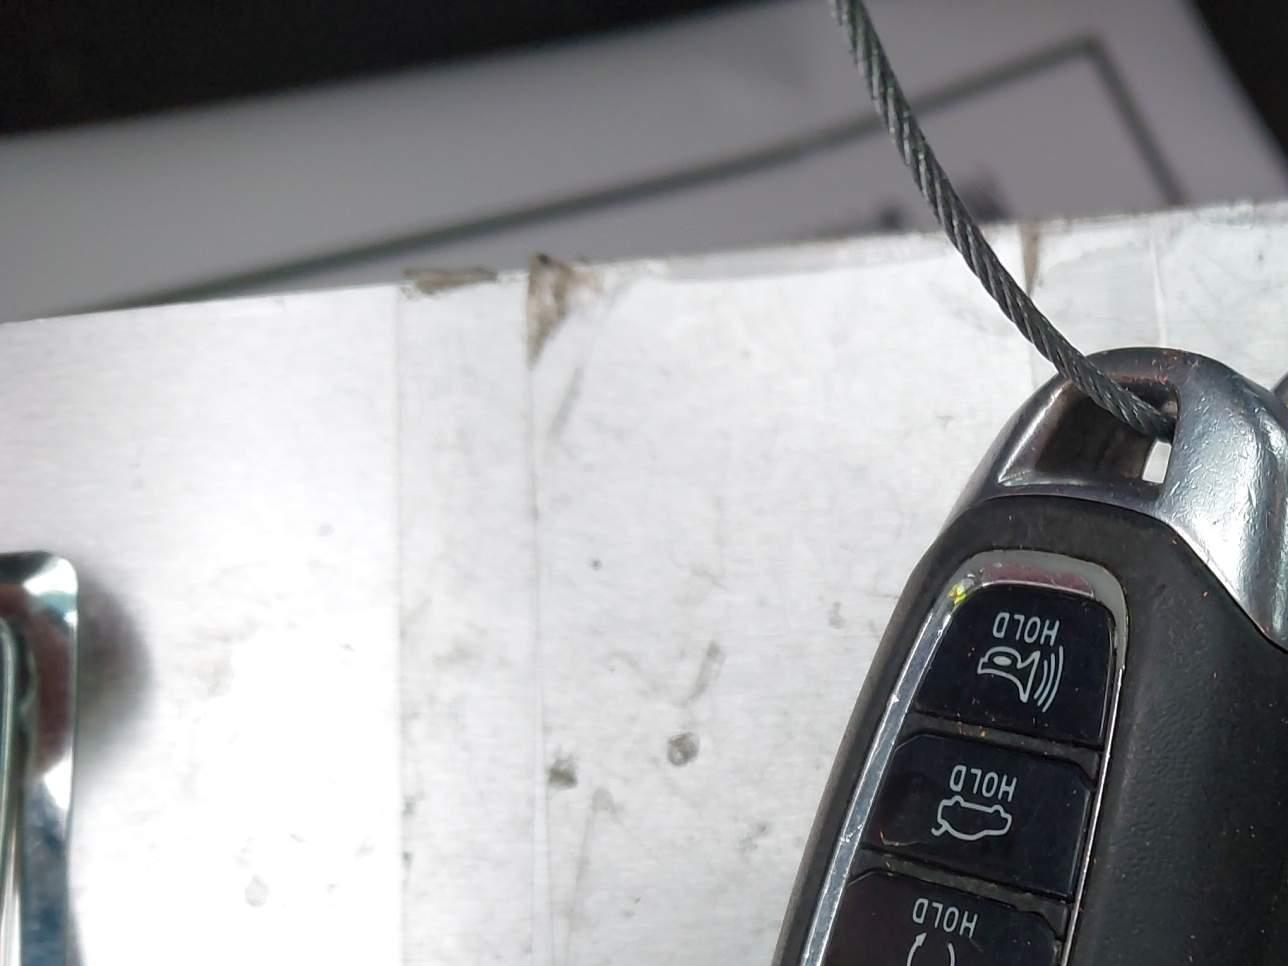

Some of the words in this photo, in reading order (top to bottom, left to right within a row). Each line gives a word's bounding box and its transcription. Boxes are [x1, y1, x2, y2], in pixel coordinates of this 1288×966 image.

[992, 612, 1060, 646] HOLD
[949, 764, 1018, 802] HOLD
[912, 898, 979, 938] HOLD
